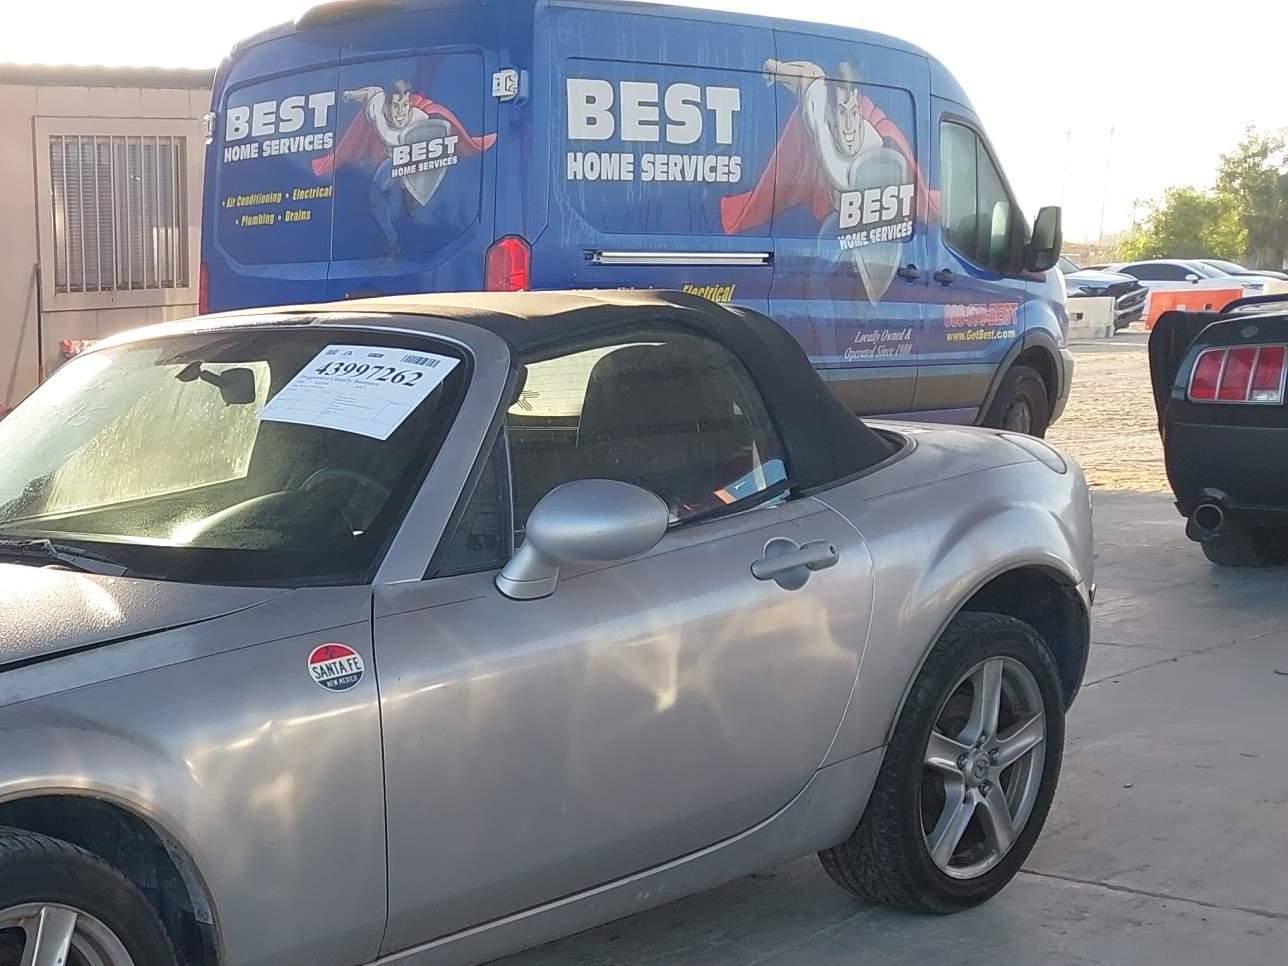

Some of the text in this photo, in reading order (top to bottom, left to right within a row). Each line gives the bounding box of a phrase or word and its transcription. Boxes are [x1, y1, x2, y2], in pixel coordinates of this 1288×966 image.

[226, 91, 336, 142] BEST
[566, 78, 741, 145] BEST
[224, 132, 334, 163] HOME SERVICES
[393, 136, 459, 166] BEST
[392, 155, 458, 178] HOME SERVICES
[567, 152, 742, 183] HOME SERVICES
[226, 185, 333, 208] Air Conditioning Electrical
[839, 183, 915, 229] BEST
[241, 208, 312, 227] Plumbing Drains
[837, 220, 913, 251] HOME SERVICES
[854, 328, 913, 345] Locally Owned &
[946, 328, 1016, 342] www.GetBest.com
[844, 345, 876, 362] Operated
[875, 344, 894, 357] Since
[315, 360, 424, 387] 43997262
[312, 657, 362, 680] SANTA FE
